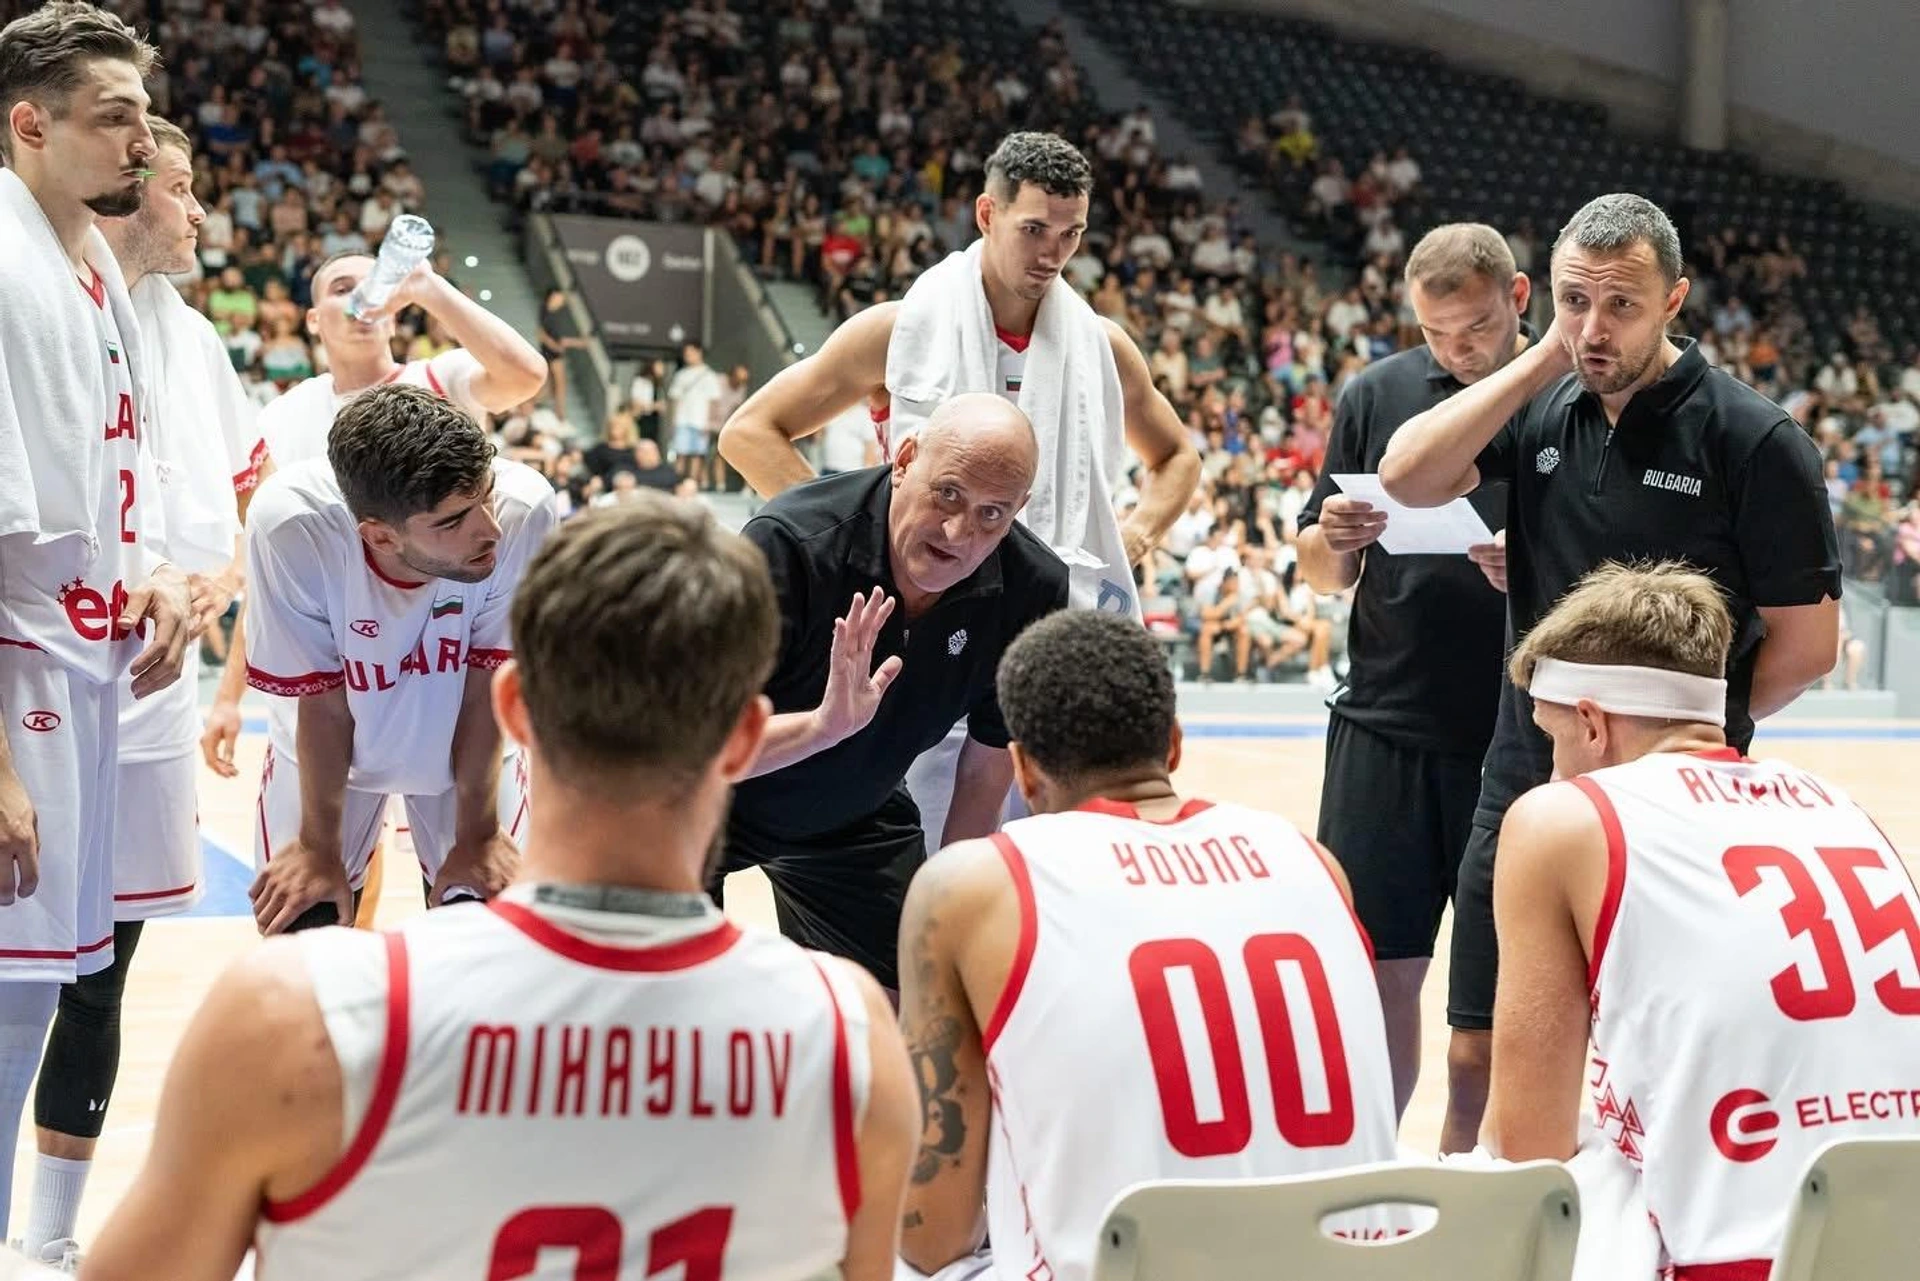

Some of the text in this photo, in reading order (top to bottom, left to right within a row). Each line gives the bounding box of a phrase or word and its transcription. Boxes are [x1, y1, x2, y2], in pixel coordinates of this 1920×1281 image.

[1643, 469, 1702, 497] BULGARIA
[1112, 836, 1271, 885] YOUNG
[1721, 845, 1920, 1021] 35
[455, 1024, 793, 1119] MIHAYLOV
[1128, 932, 1355, 1159] 00
